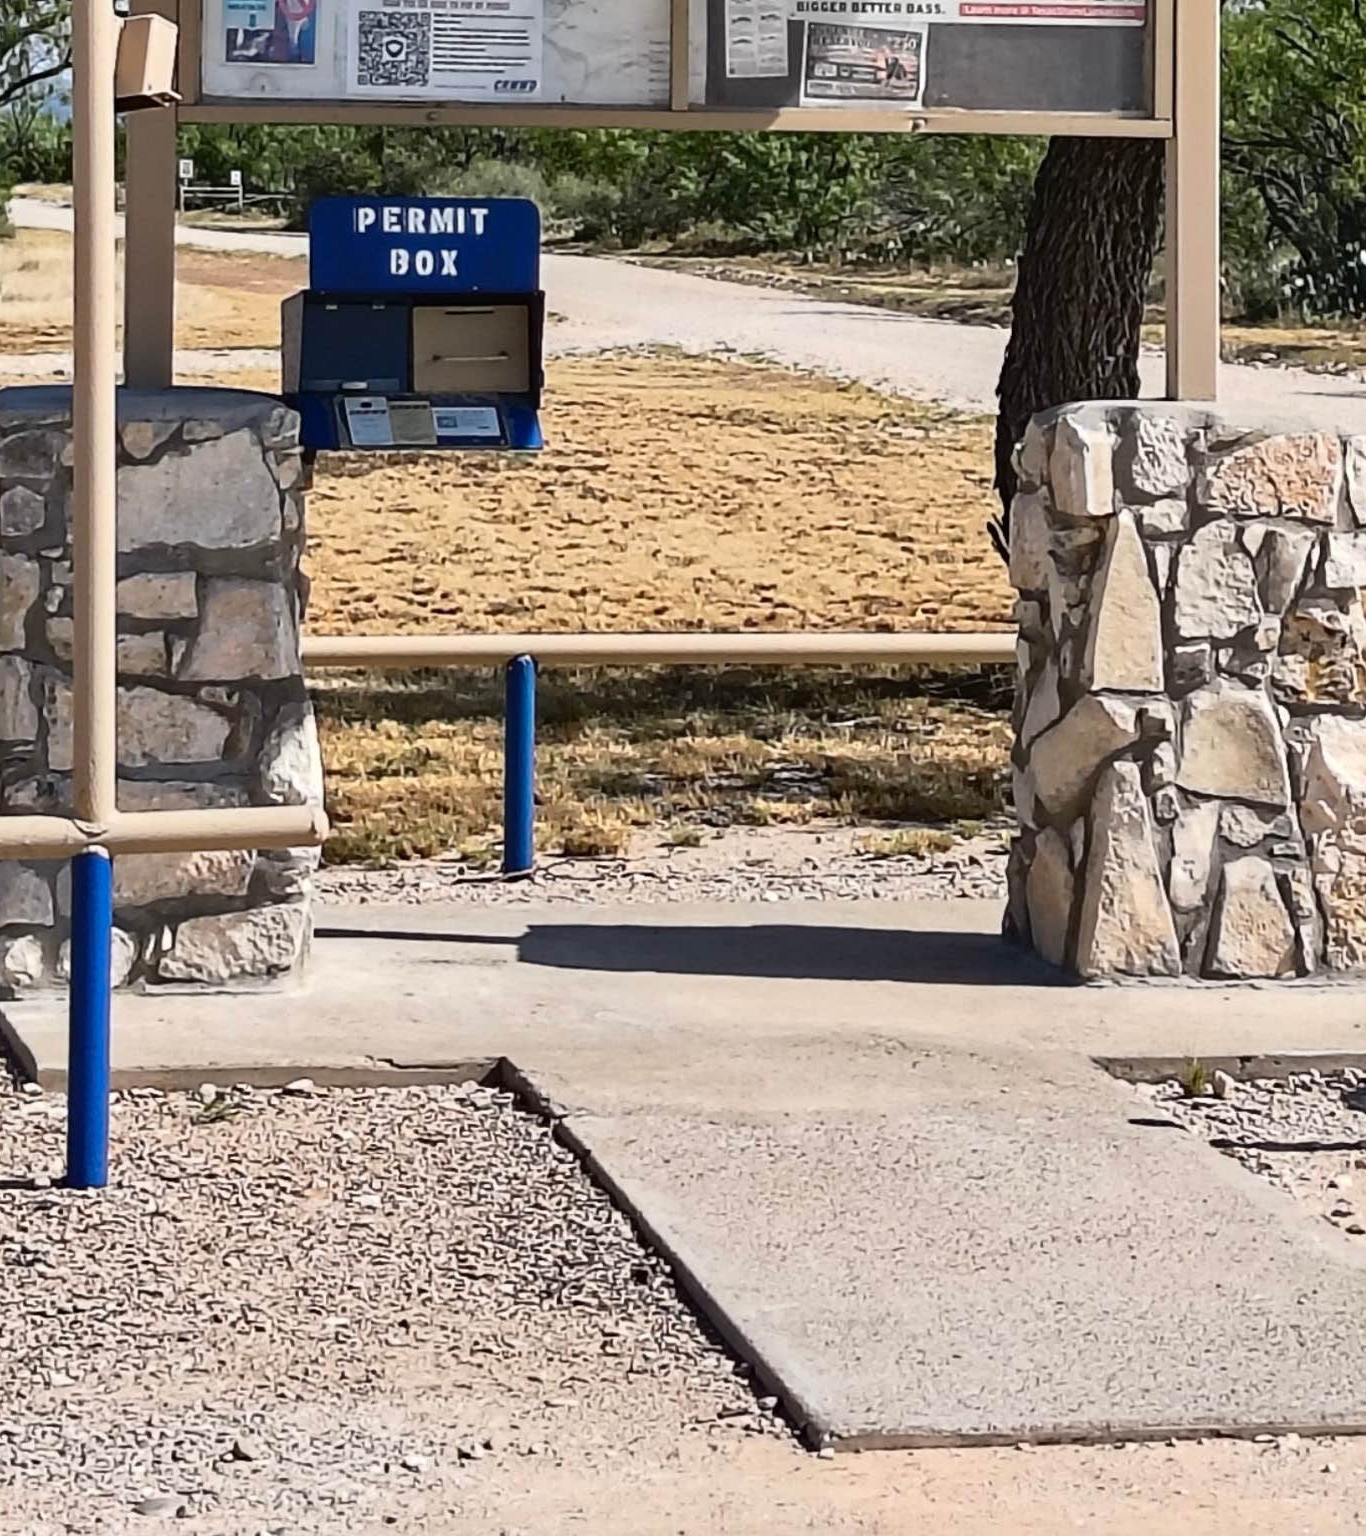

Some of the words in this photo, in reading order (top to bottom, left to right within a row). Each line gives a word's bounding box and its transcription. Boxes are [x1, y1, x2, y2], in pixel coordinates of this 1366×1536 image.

[796, 1, 848, 13] BIGGER
[851, 1, 902, 14] BETTER
[906, 3, 946, 15] BASS.
[355, 206, 489, 234] PERMIT
[390, 248, 459, 276] BOX
